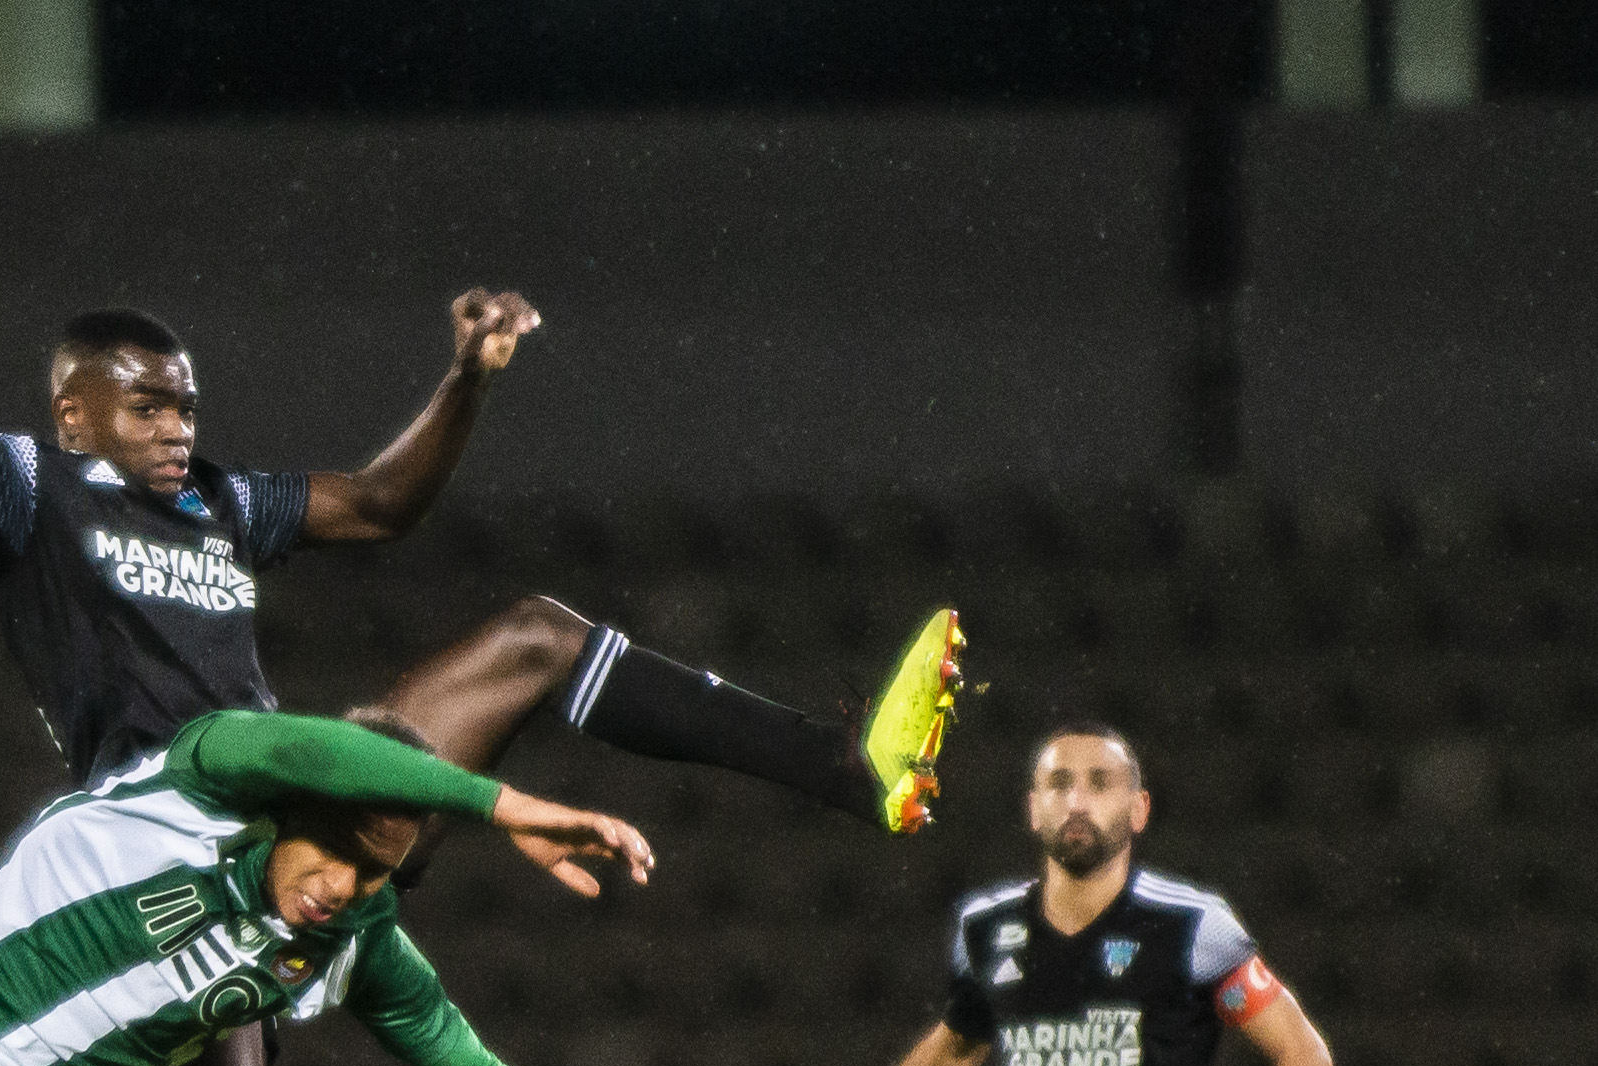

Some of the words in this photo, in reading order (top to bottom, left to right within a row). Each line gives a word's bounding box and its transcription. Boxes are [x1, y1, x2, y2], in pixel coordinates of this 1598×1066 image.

[95, 530, 252, 589] MARINHA
[116, 563, 256, 612] GRANDE
[136, 883, 264, 1027] MEO
